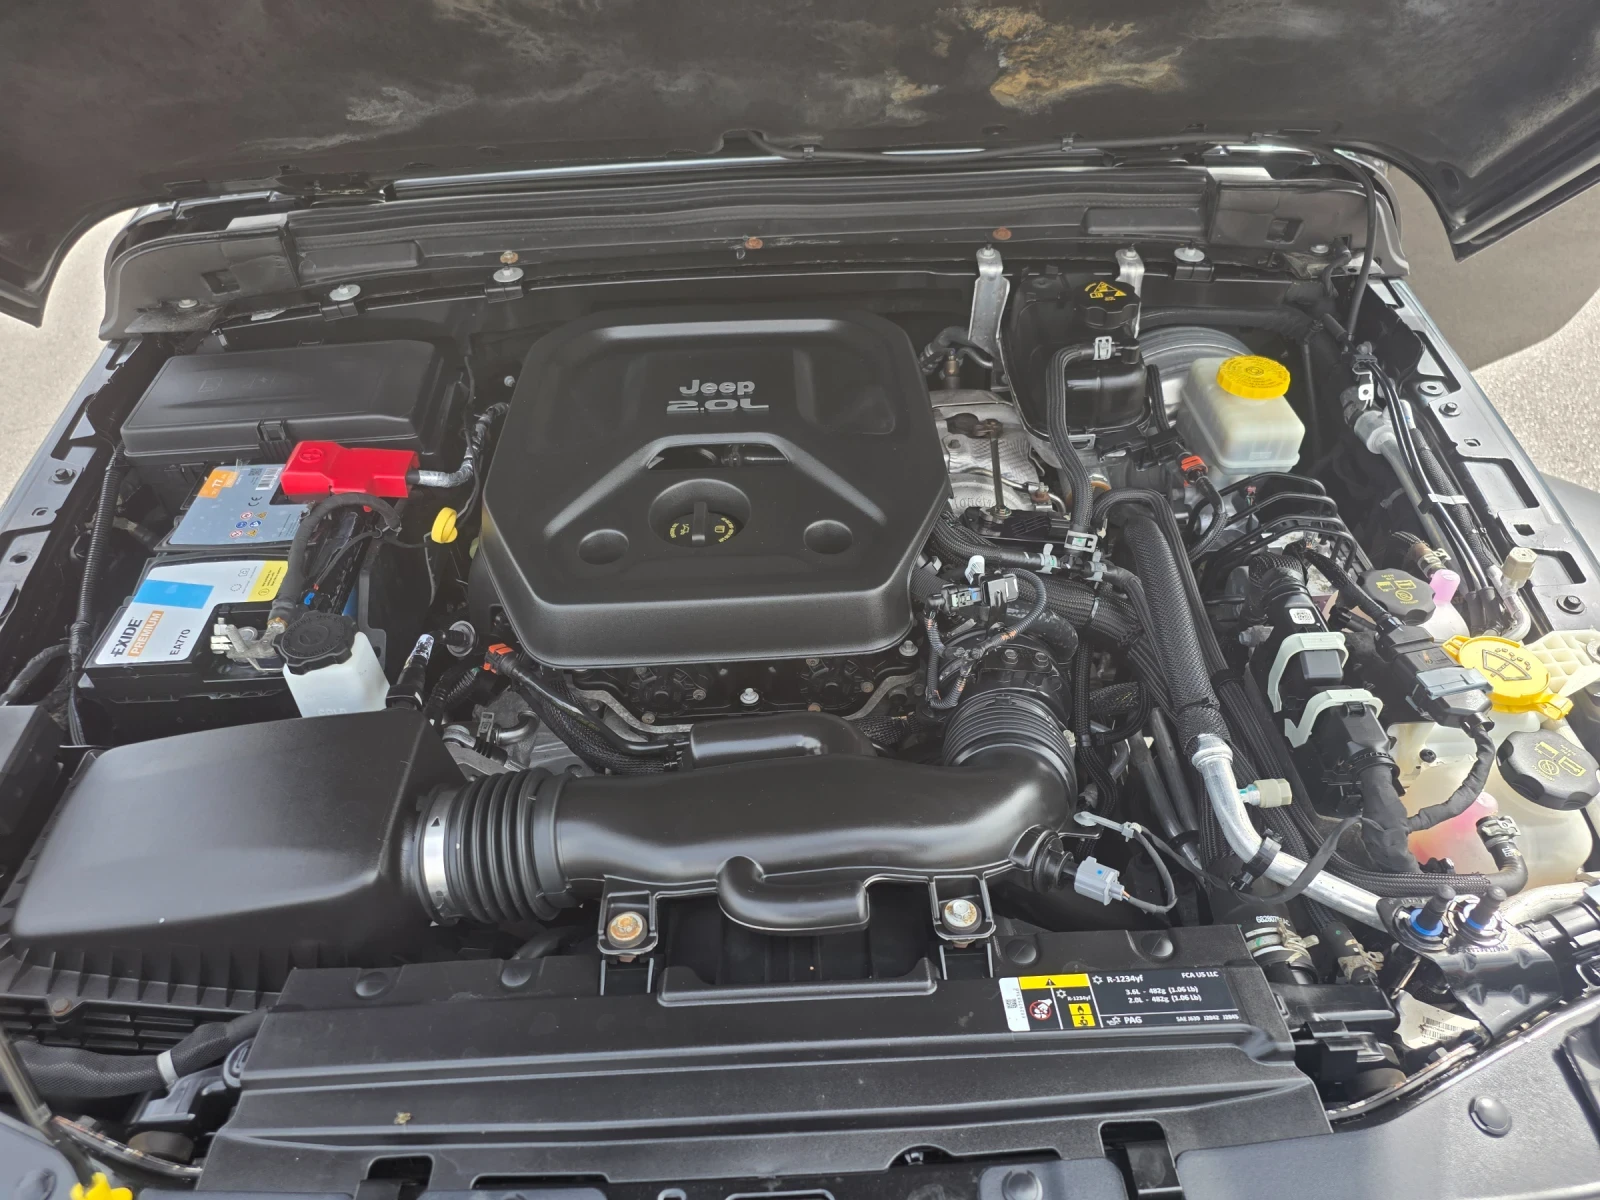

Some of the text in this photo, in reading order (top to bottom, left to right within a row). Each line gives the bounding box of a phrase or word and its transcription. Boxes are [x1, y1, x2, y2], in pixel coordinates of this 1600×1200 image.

[679, 379, 756, 396] Jeep
[666, 398, 769, 412] 2.0L
[110, 618, 143, 658] EXIDE
[129, 612, 162, 655] PREMIUM
[168, 628, 191, 656] EA770
[1106, 974, 1144, 984] R-1234yf
[1181, 971, 1196, 979] FCA
[1206, 970, 1220, 978] LLC
[1124, 988, 1141, 996] 3.6L
[1148, 987, 1167, 995] 482g
[1127, 996, 1144, 1004] 2.0L
[1151, 995, 1170, 1003] 482g
[1123, 1015, 1143, 1025] PAG
